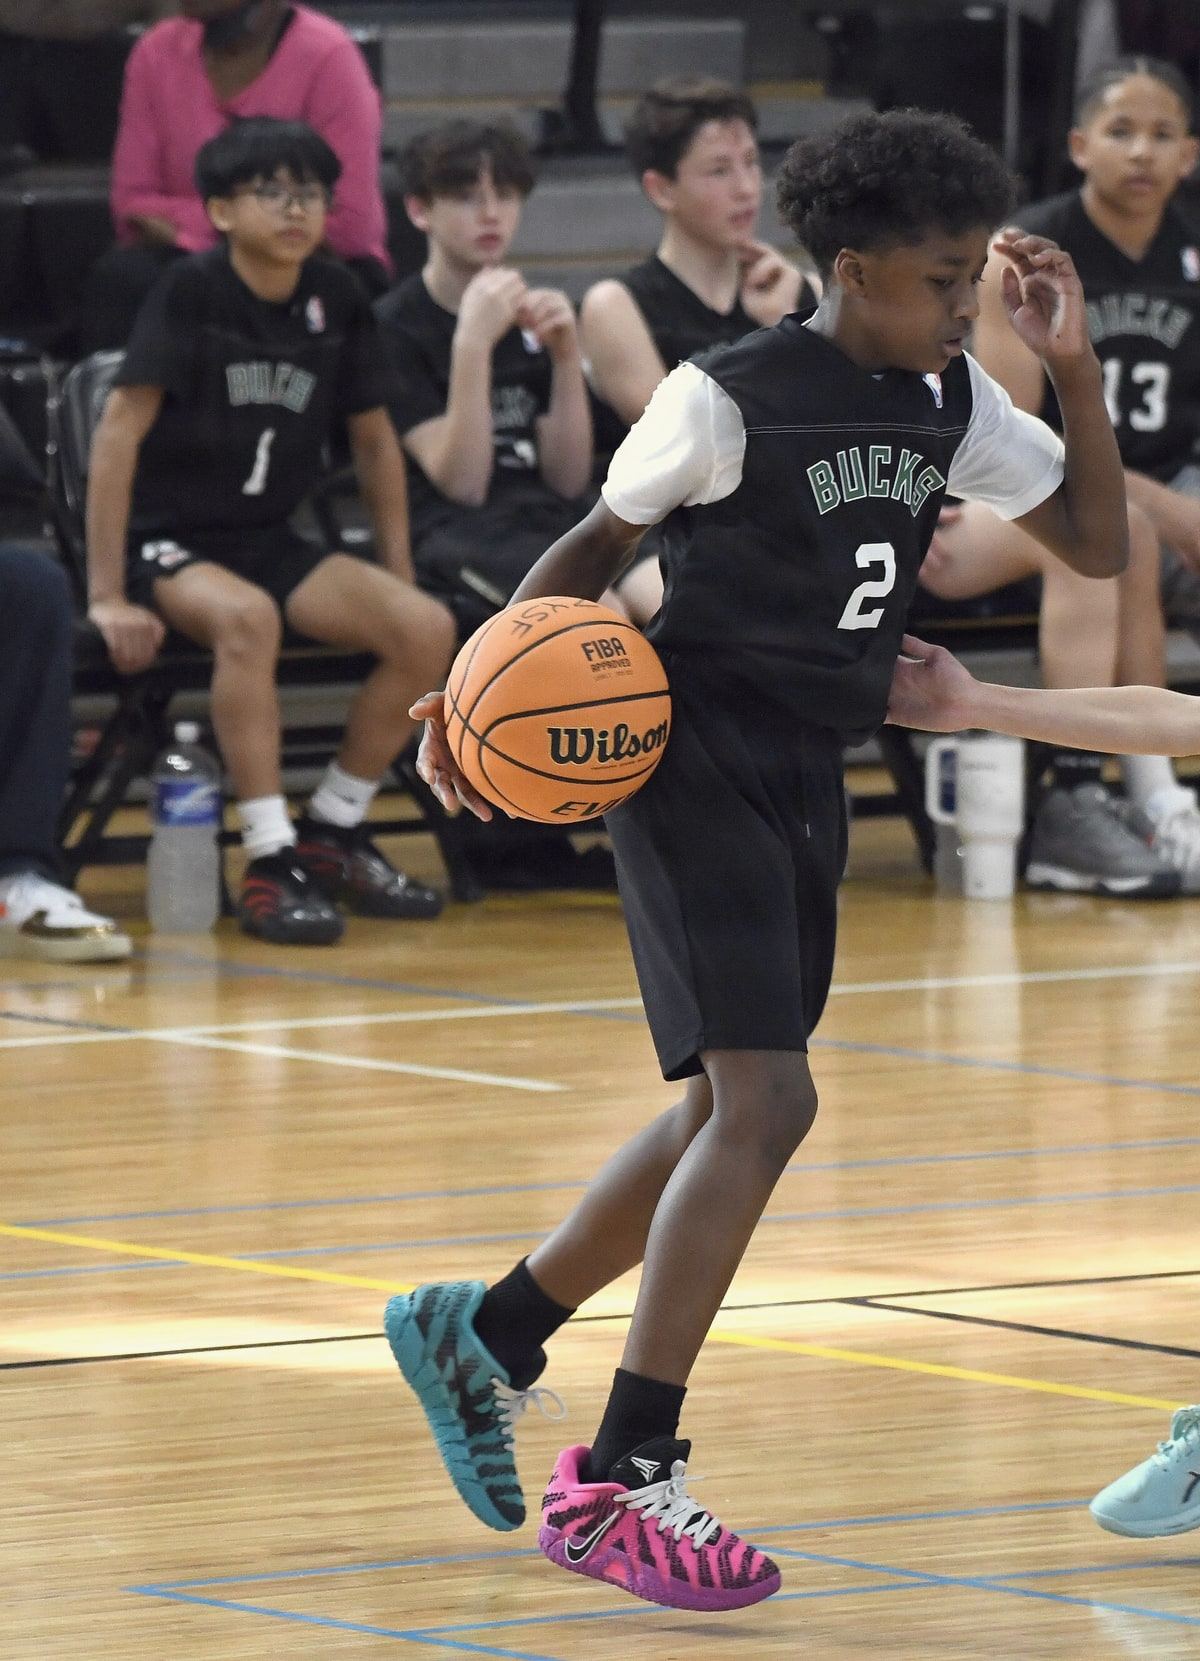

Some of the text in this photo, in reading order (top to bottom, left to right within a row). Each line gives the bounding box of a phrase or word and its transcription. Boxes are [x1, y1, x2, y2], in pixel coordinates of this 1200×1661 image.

[1102, 357, 1171, 432] 13
[242, 427, 276, 496] 1
[806, 445, 946, 518] BUCKS
[837, 542, 896, 630] 2
[581, 637, 627, 661] FIBA
[546, 718, 668, 765] Wilson
